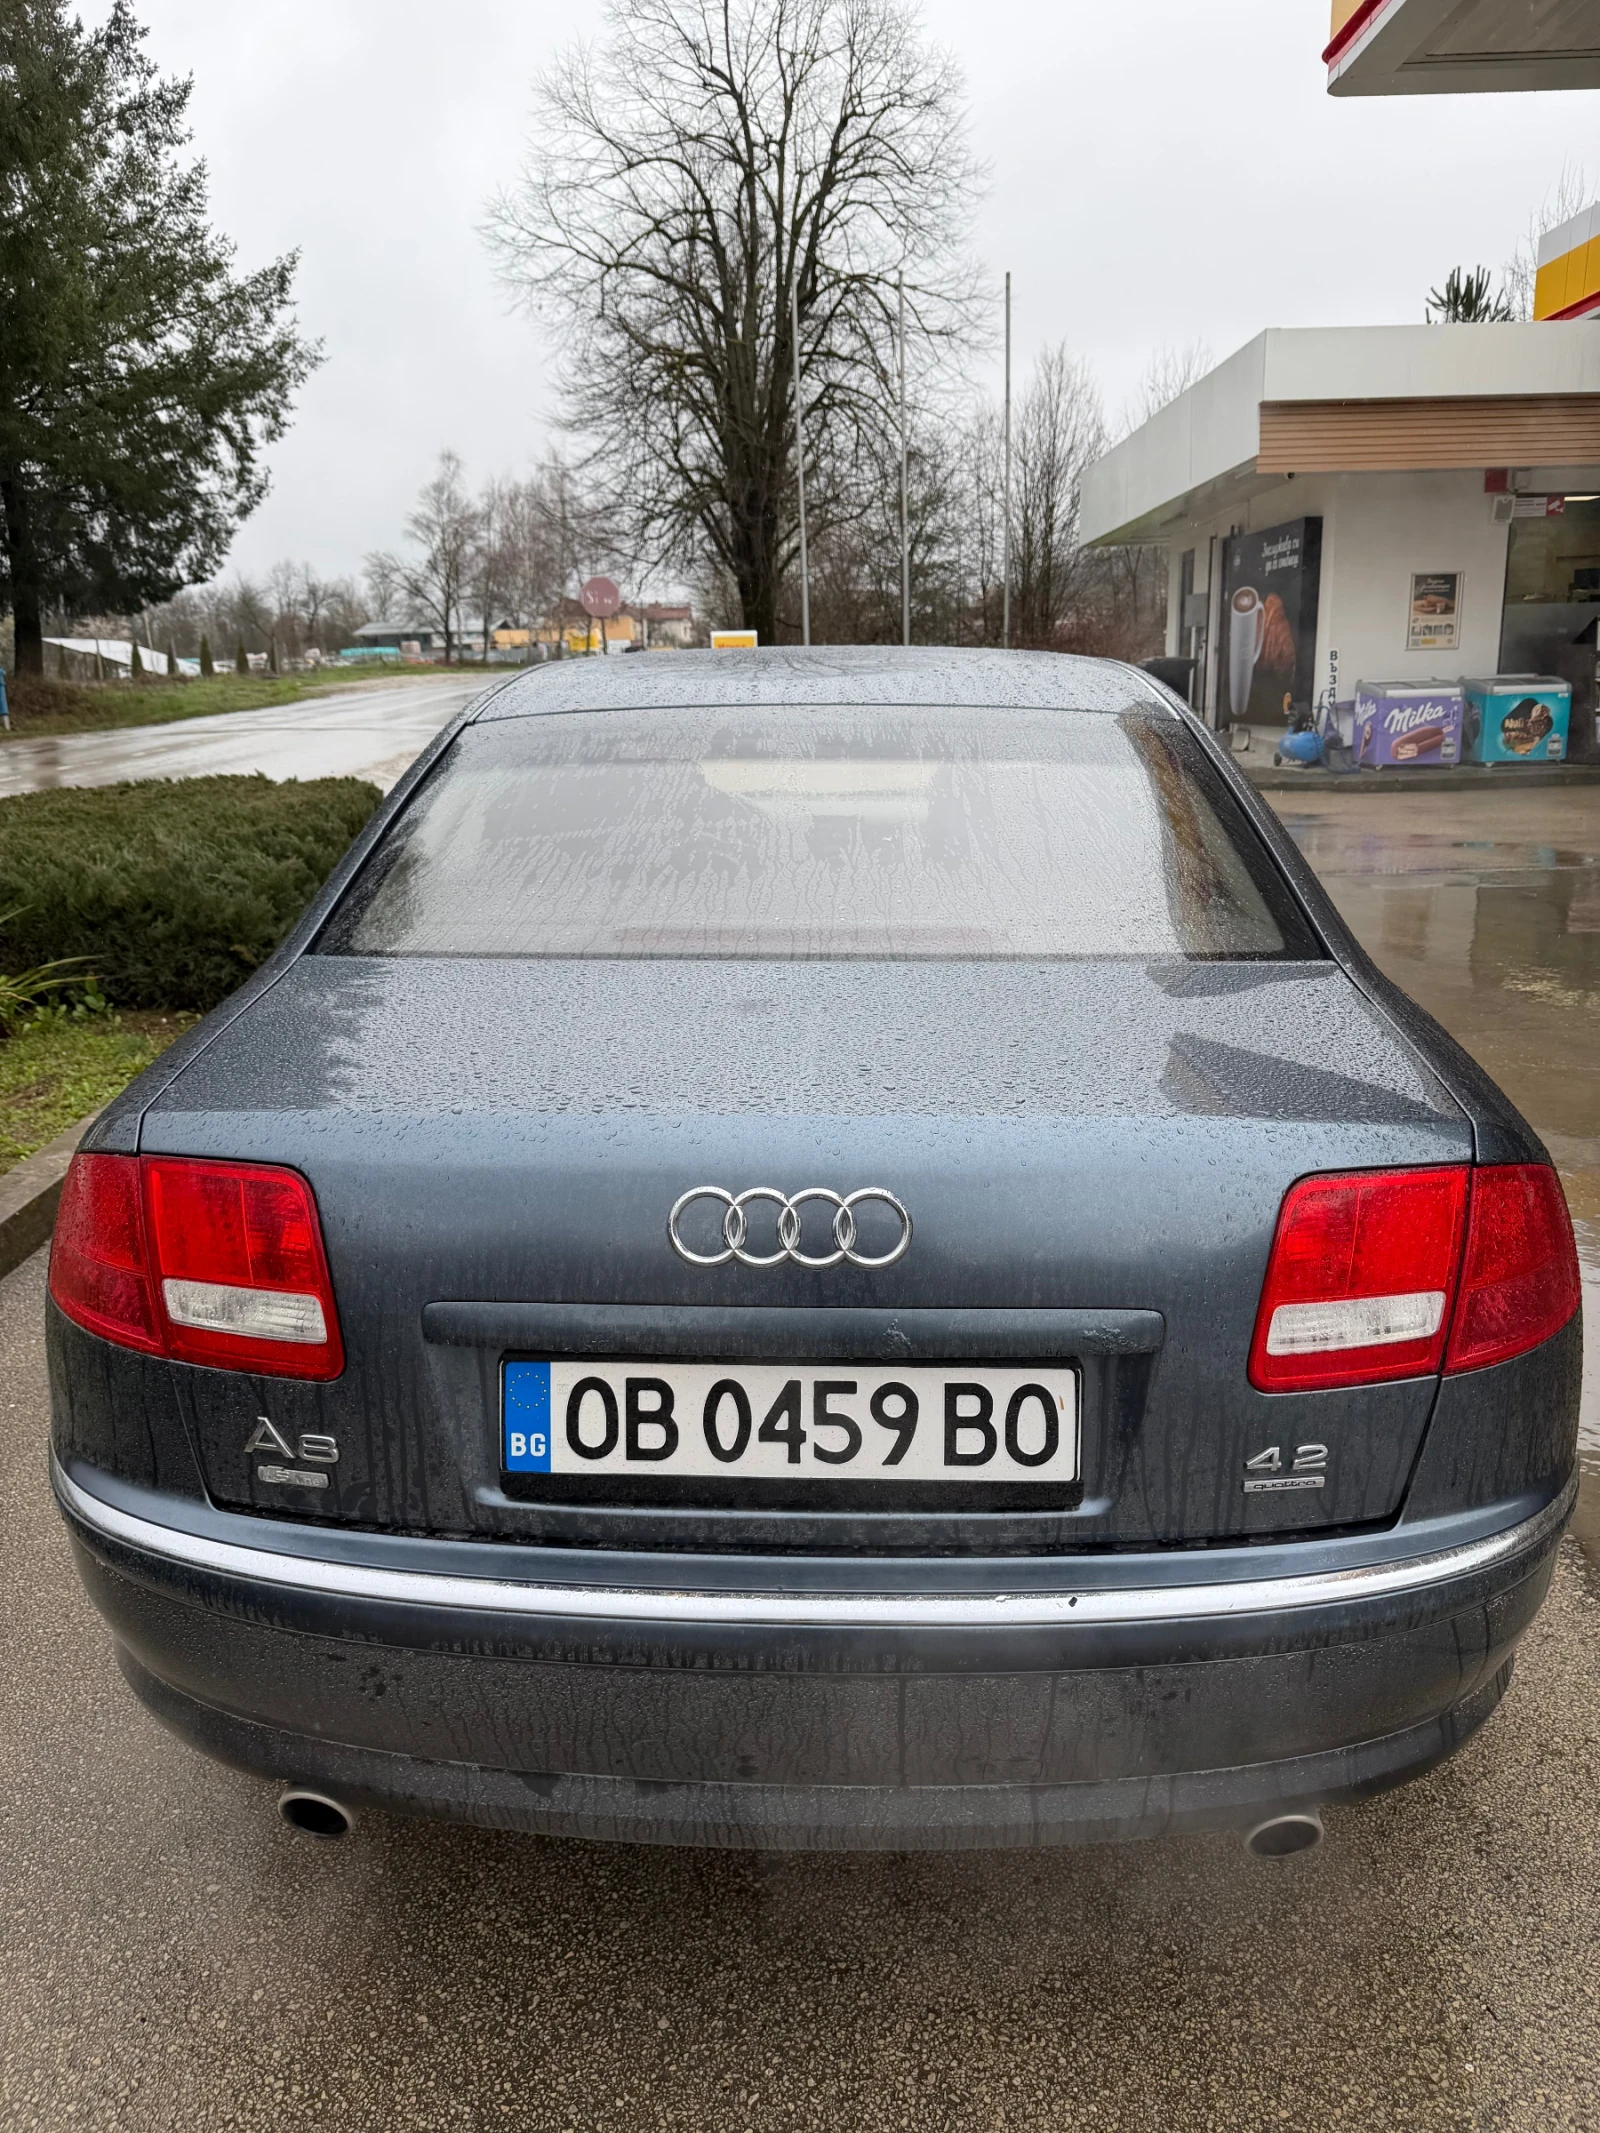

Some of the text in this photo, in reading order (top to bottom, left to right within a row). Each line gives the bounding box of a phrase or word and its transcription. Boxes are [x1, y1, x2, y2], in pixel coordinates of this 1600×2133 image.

[1384, 702, 1446, 734] Milka
[244, 1416, 340, 1464] A8
[510, 1432, 546, 1457] BG
[702, 1378, 920, 1466] 0459
[1254, 1480, 1316, 1490] quattro
